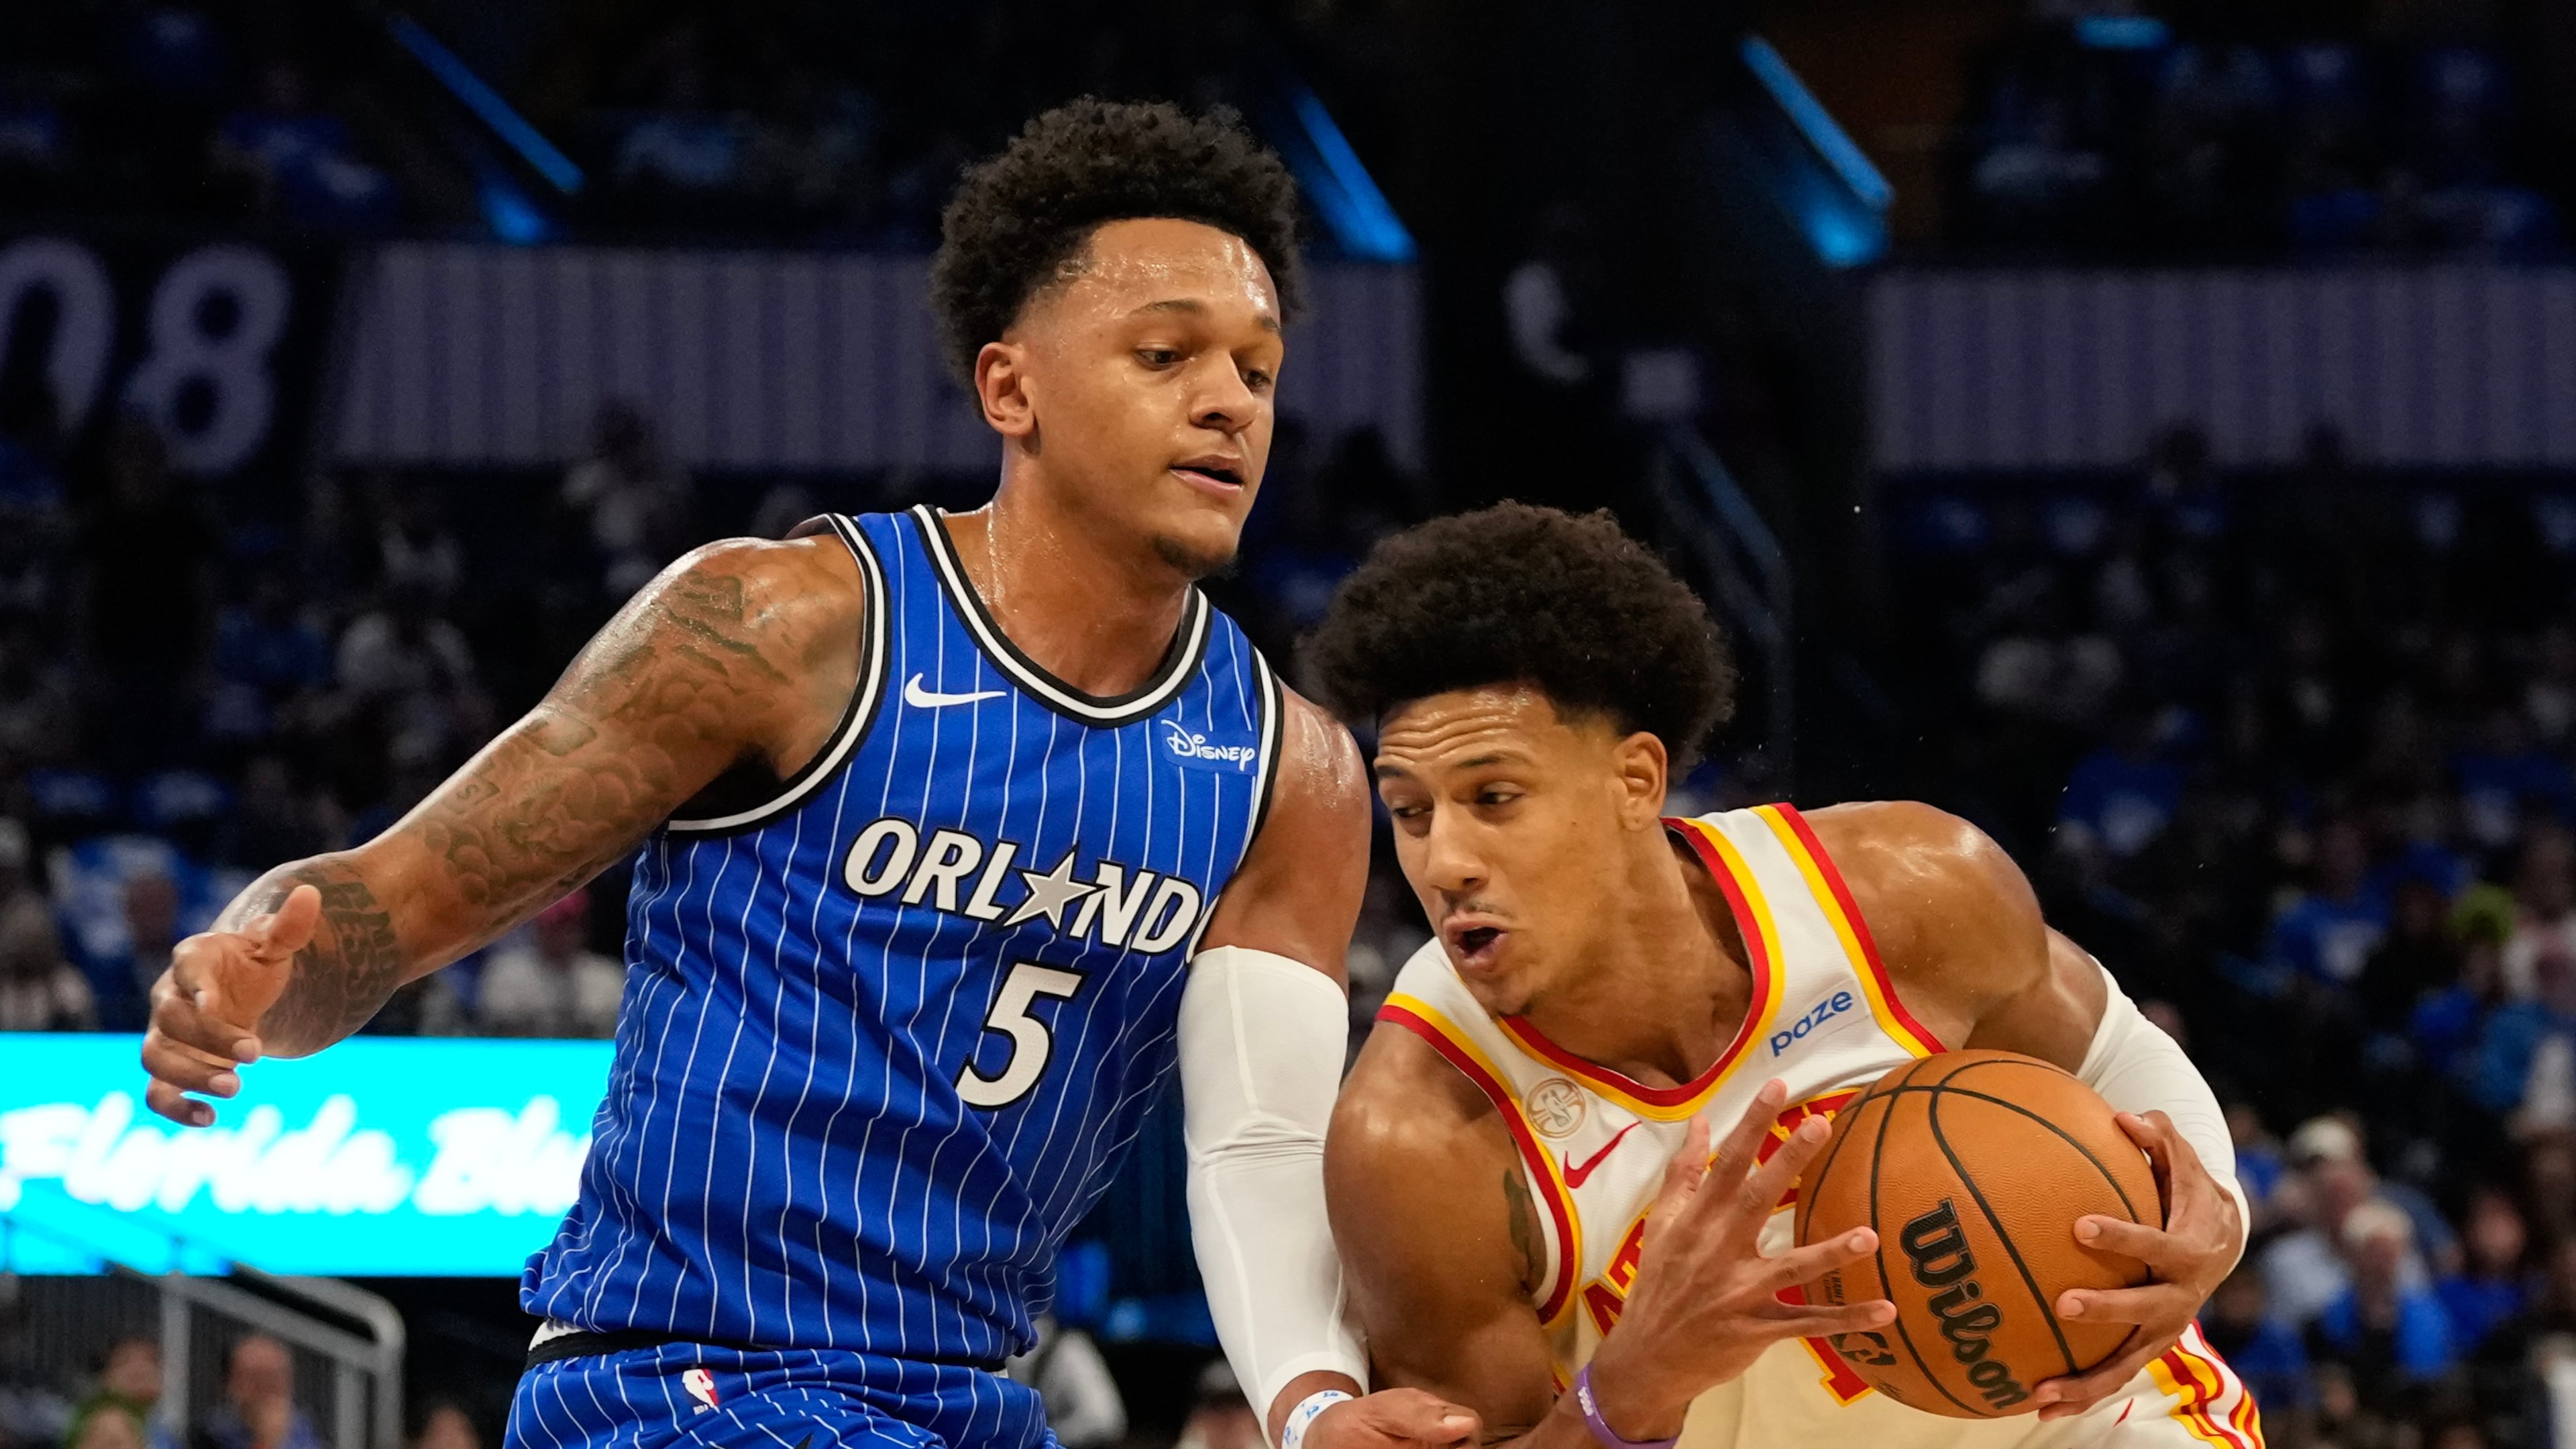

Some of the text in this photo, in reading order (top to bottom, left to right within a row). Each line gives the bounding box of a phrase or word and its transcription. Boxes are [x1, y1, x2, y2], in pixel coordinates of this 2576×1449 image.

[1161, 719, 1256, 771] Disney
[953, 961, 1086, 1109] 5
[1770, 991, 1853, 1058] paze
[0, 1091, 415, 1213] Florida
[1900, 1197, 2029, 1410] Wilson
